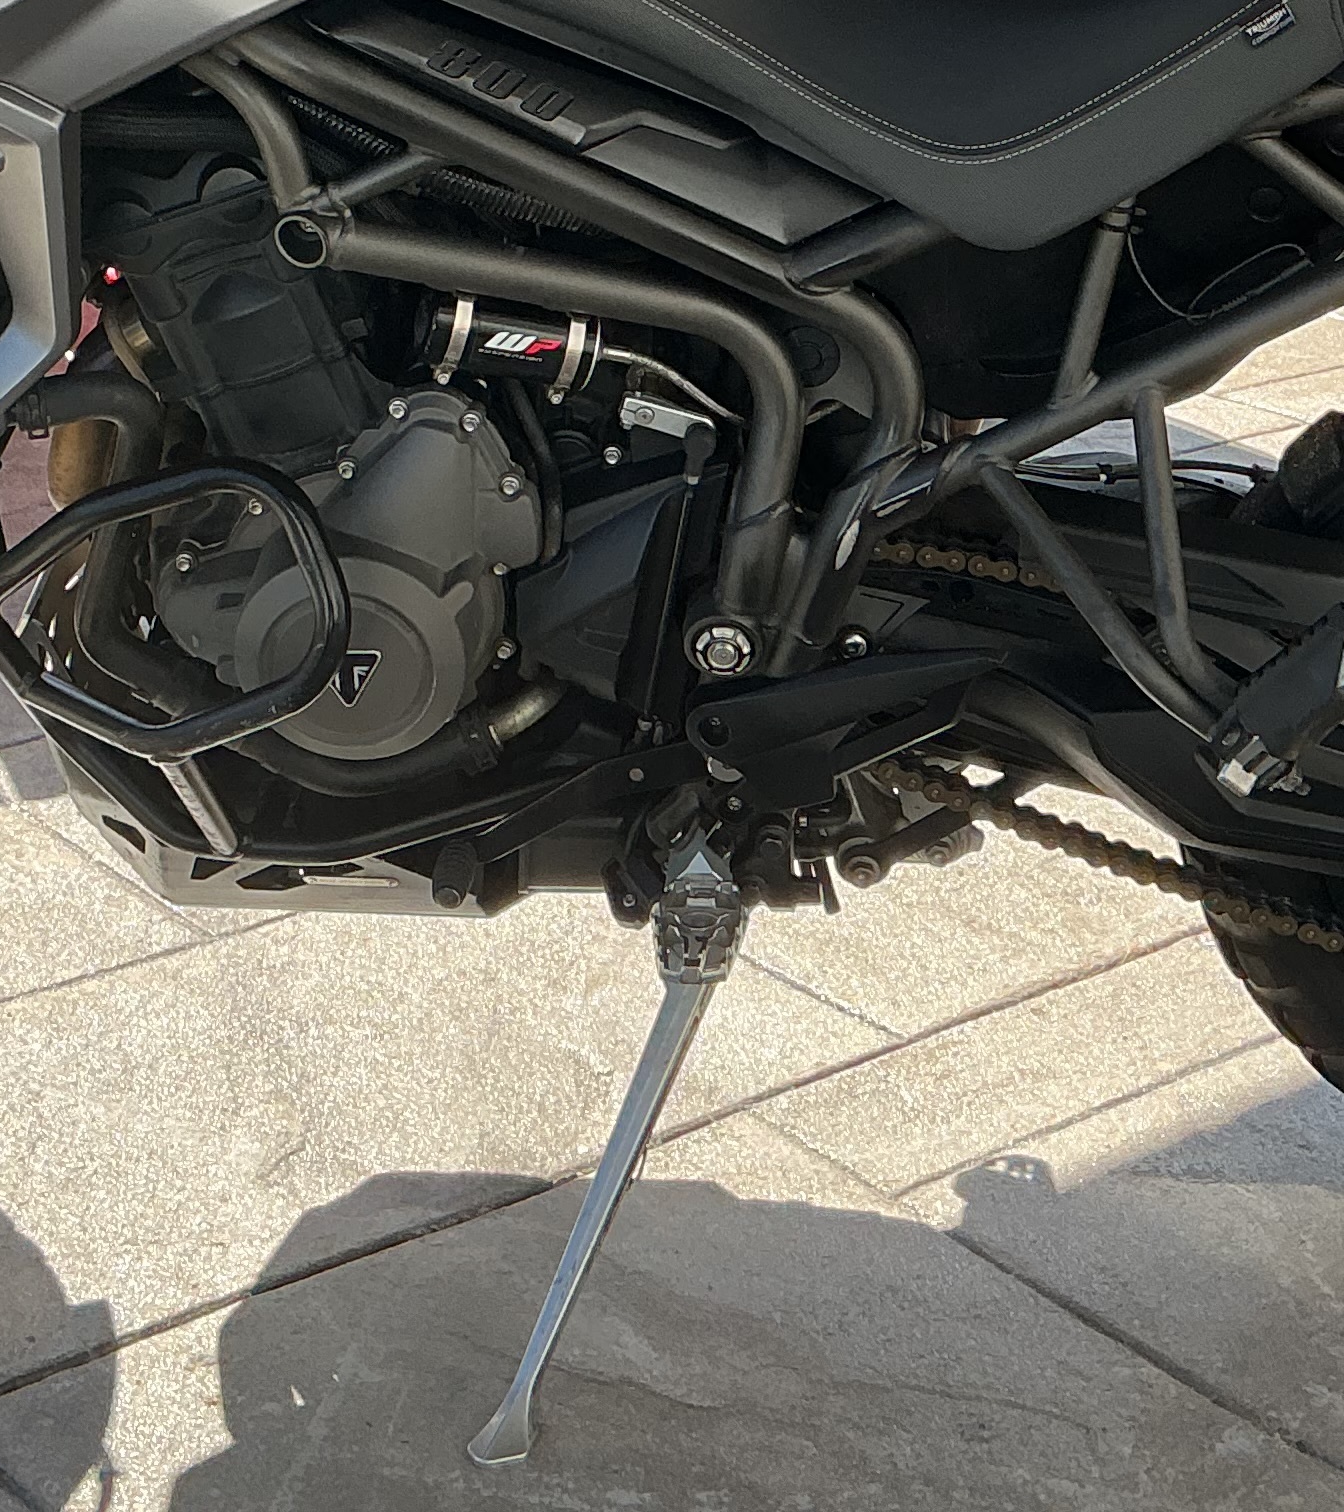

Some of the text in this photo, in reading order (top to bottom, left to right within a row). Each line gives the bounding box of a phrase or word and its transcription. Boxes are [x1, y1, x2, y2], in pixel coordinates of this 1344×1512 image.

[1244, 7, 1287, 37] TRIUMPH
[426, 39, 574, 122] 800
[483, 331, 564, 356] WP
